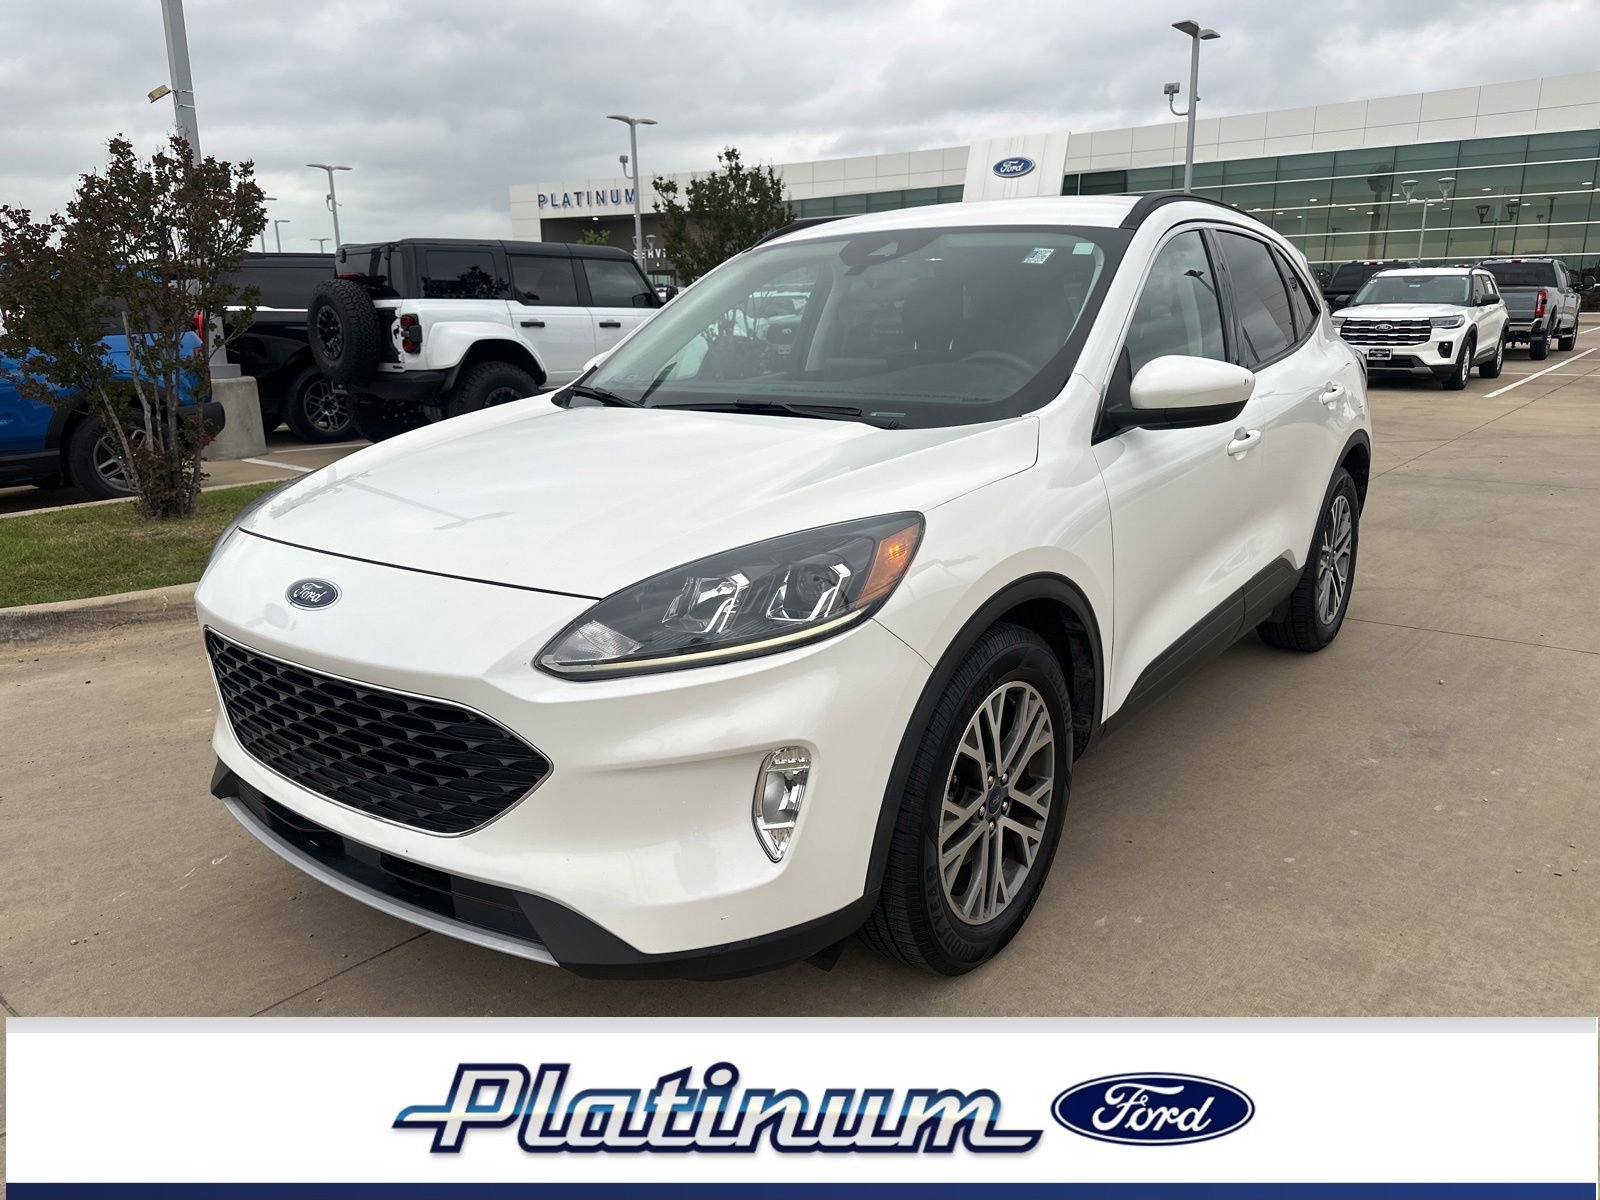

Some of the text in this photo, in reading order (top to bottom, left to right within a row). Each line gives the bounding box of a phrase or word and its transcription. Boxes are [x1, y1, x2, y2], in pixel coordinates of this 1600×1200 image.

[1001, 160, 1025, 173] Ford
[537, 188, 636, 208] PLATINUM
[293, 582, 327, 603] Ford
